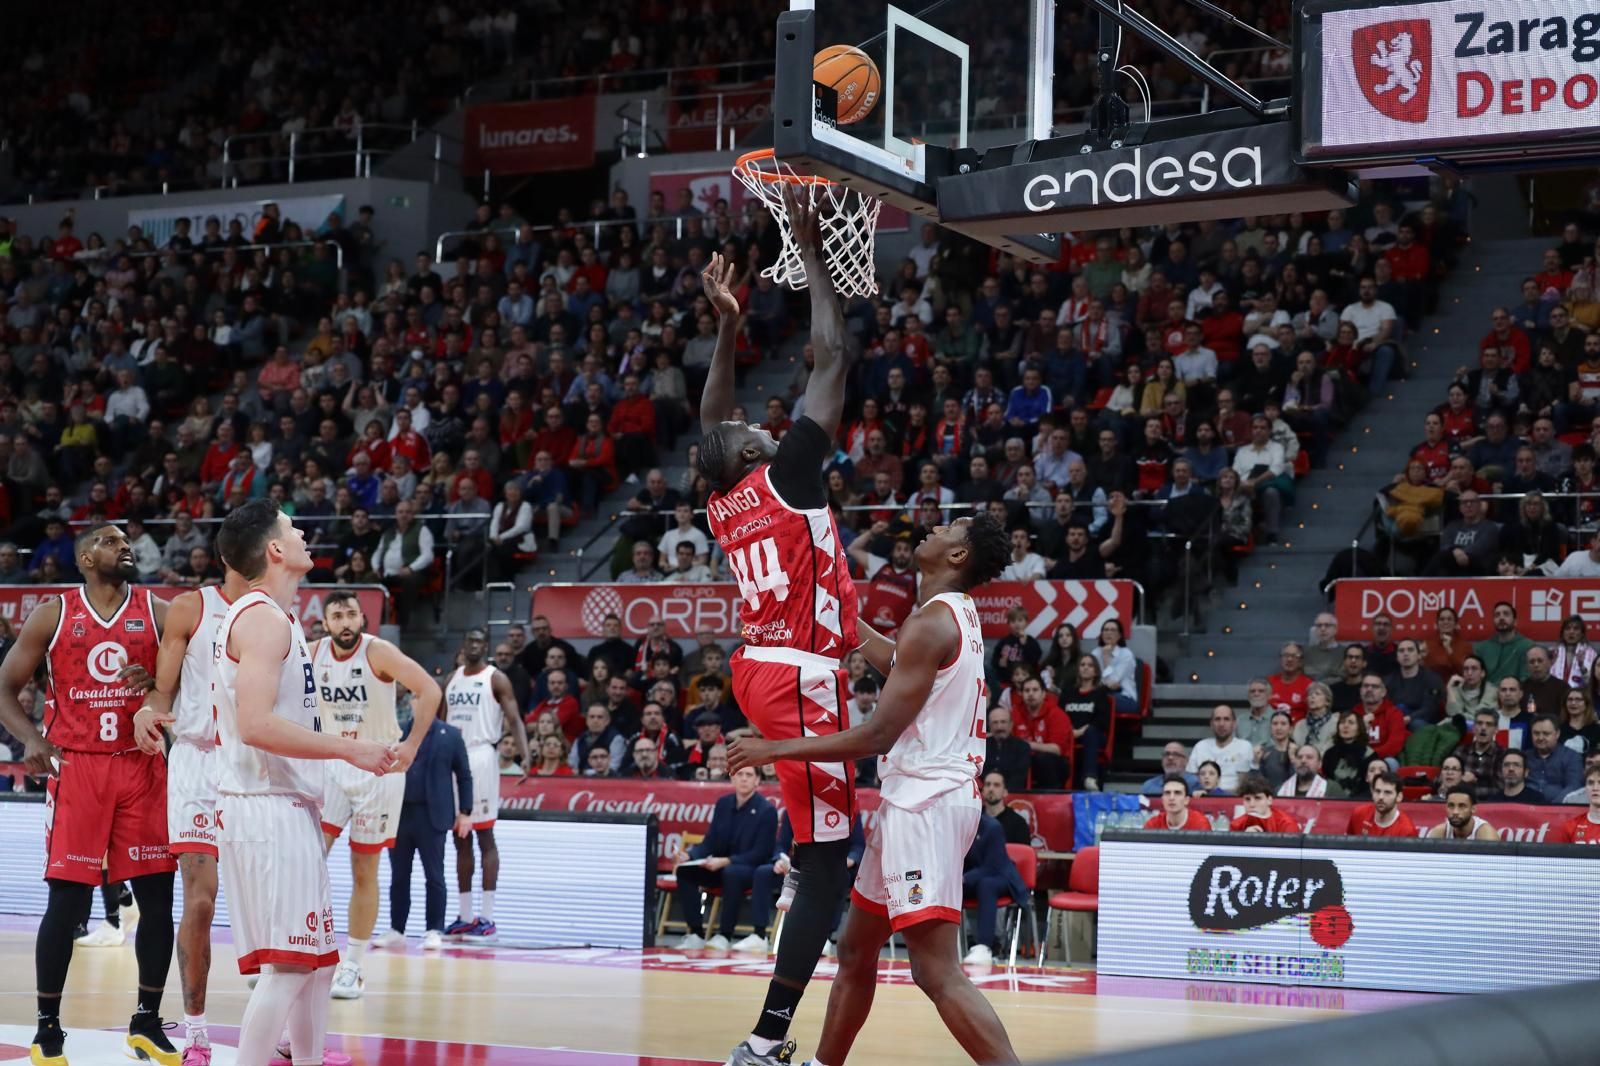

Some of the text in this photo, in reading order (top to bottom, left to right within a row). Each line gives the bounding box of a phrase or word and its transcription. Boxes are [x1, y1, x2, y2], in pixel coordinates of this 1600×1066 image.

[1455, 11, 1600, 62] Zarag
[480, 123, 578, 148] lunares.
[1024, 146, 1262, 212] endesa
[728, 537, 790, 611] 44
[673, 587, 715, 598] GRUPO
[1361, 588, 1485, 618] DOMIA
[321, 685, 367, 702] BAXI
[448, 692, 480, 705] BAXI
[100, 712, 118, 741] 8
[568, 790, 716, 823] Casademon
[141, 845, 170, 853] Zaragoz
[1204, 865, 1326, 918] Roler
